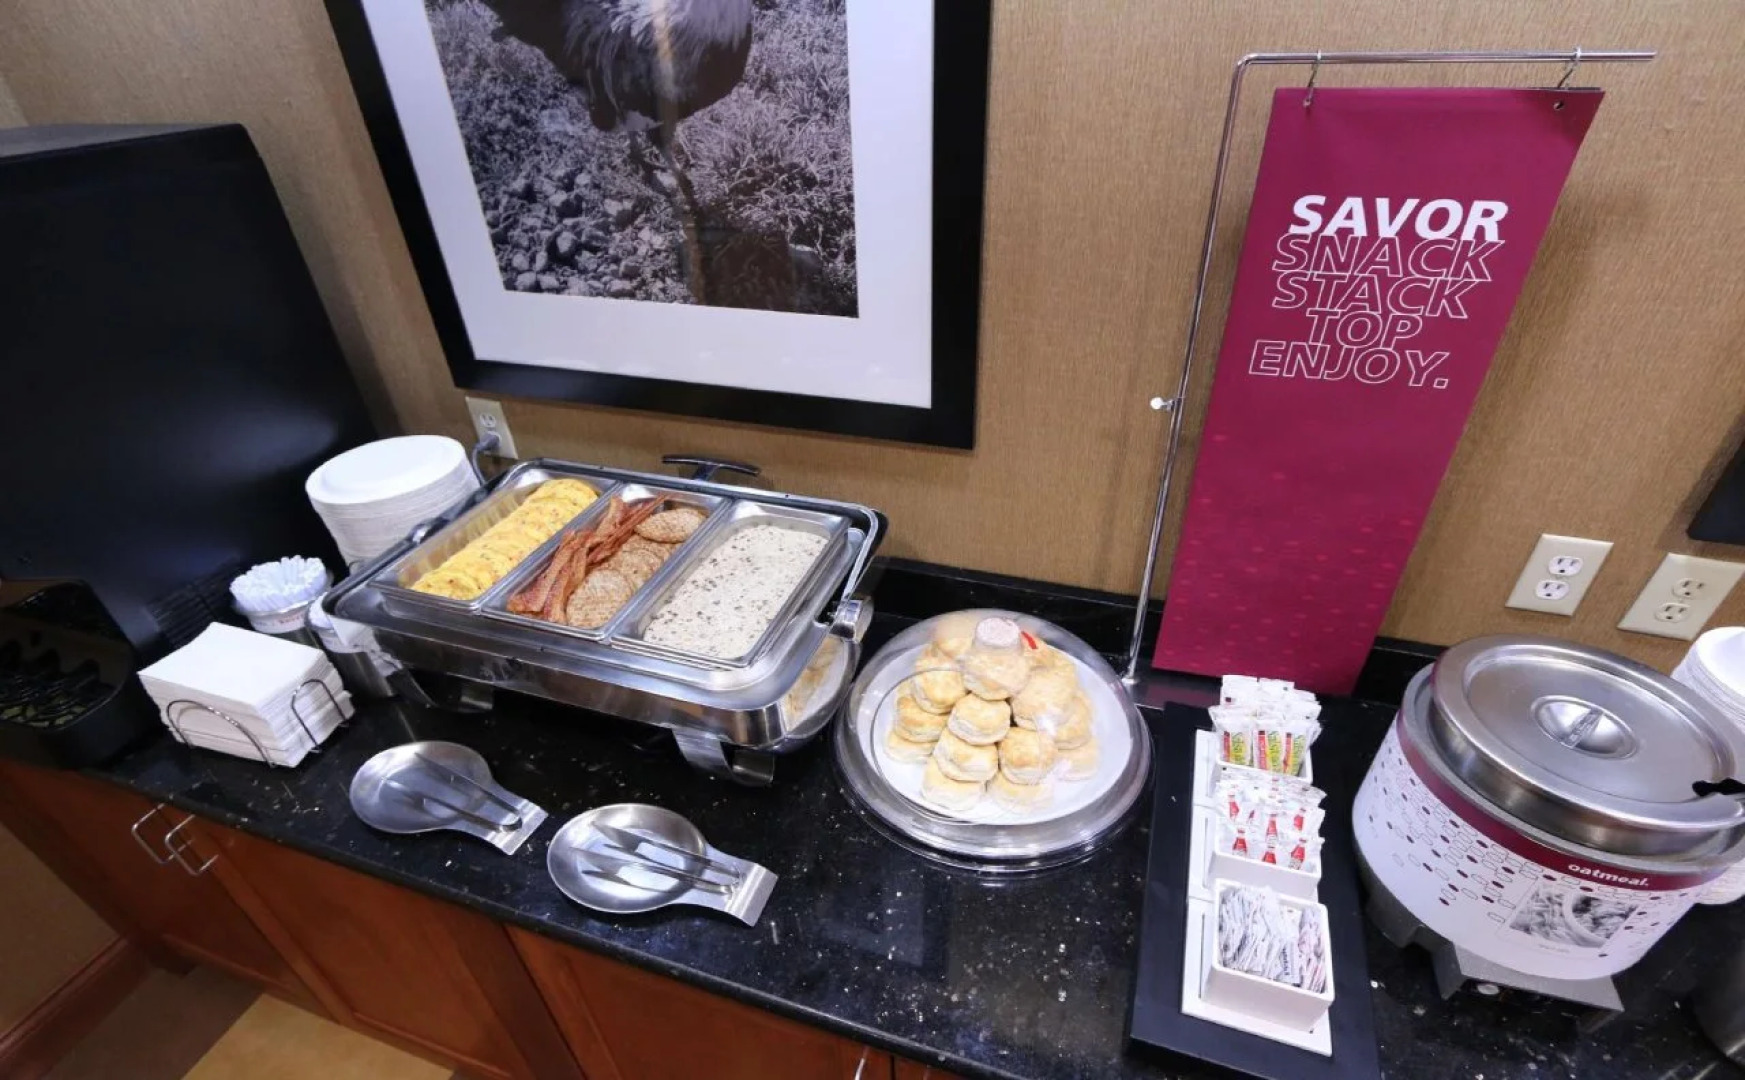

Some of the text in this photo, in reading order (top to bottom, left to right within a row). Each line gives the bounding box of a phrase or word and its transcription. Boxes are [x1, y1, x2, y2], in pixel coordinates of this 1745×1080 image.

[1289, 194, 1509, 241] SAVOR
[1271, 232, 1505, 281] SNACK
[1271, 270, 1481, 319] STACK
[1306, 308, 1423, 350] TOP
[1248, 339, 1450, 389] ENJOY.
[1568, 864, 1649, 887] oatmeal.
